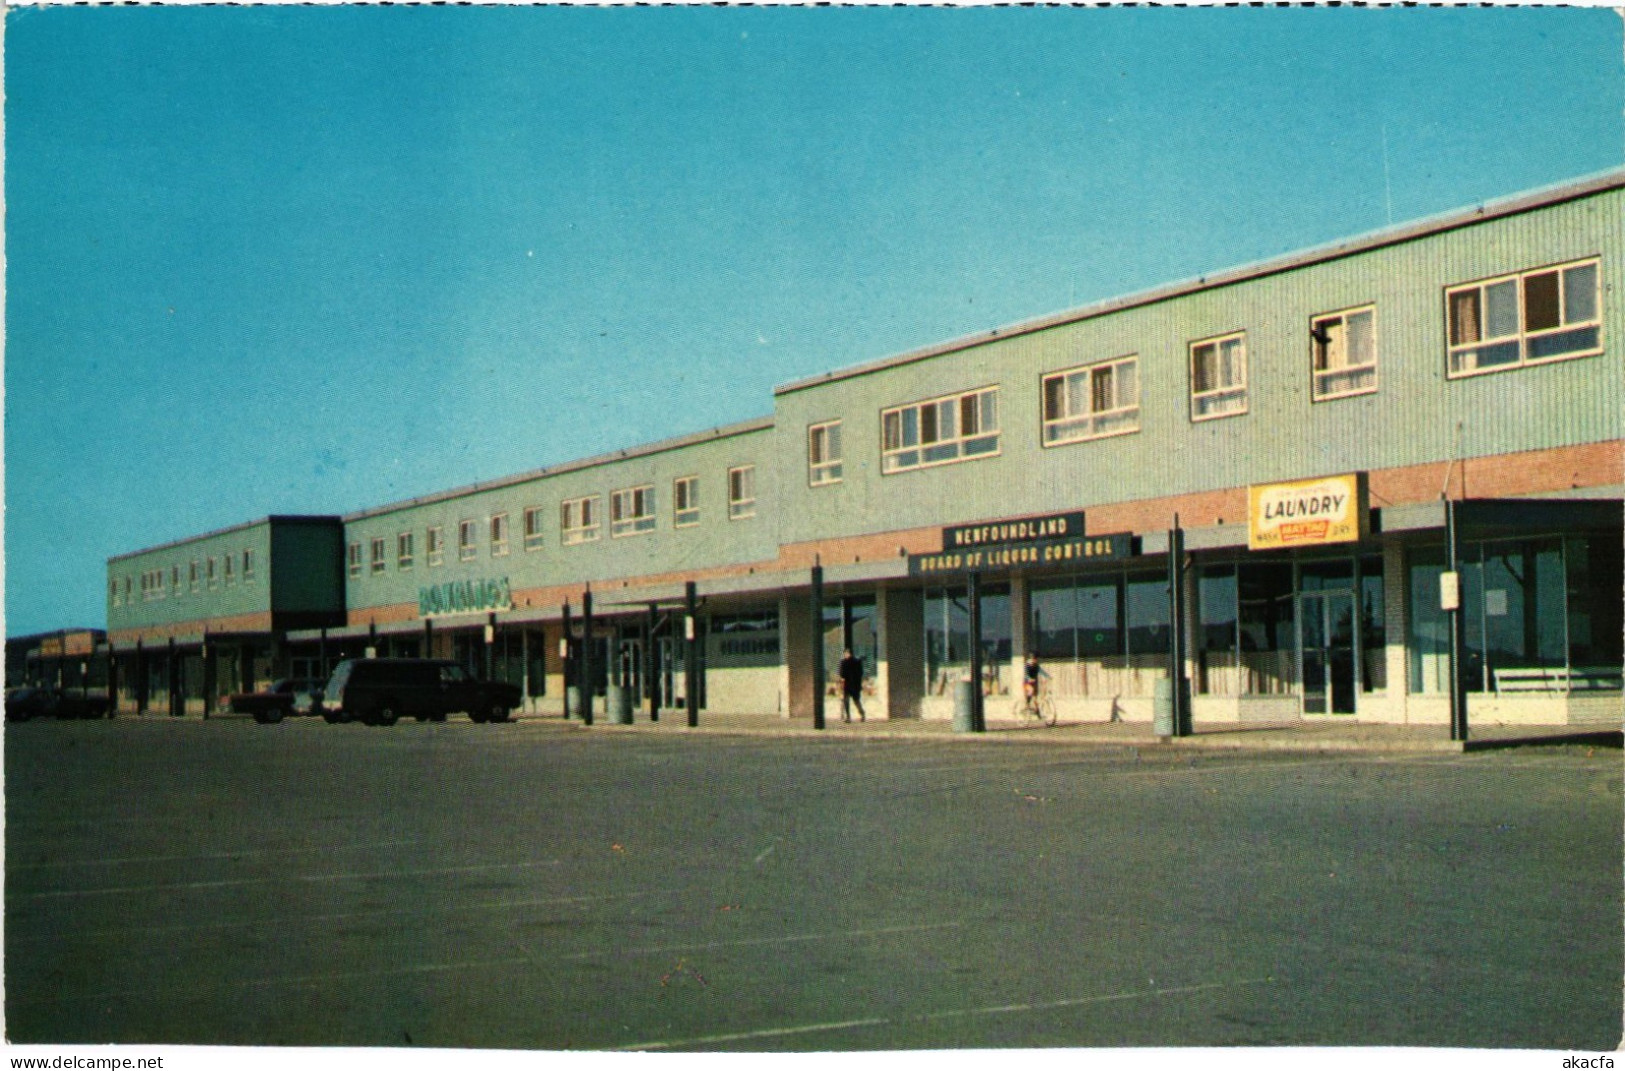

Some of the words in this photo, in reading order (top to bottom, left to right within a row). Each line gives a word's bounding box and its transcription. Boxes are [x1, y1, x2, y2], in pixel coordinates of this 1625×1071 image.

[1265, 494, 1345, 519] LAUNDRY
[955, 518, 1067, 545] NEWFOUNDLAND
[920, 553, 961, 572] BOARD
[966, 552, 983, 567] OF
[987, 546, 1038, 565] LIQUOR
[1044, 539, 1113, 561] CONTROL
